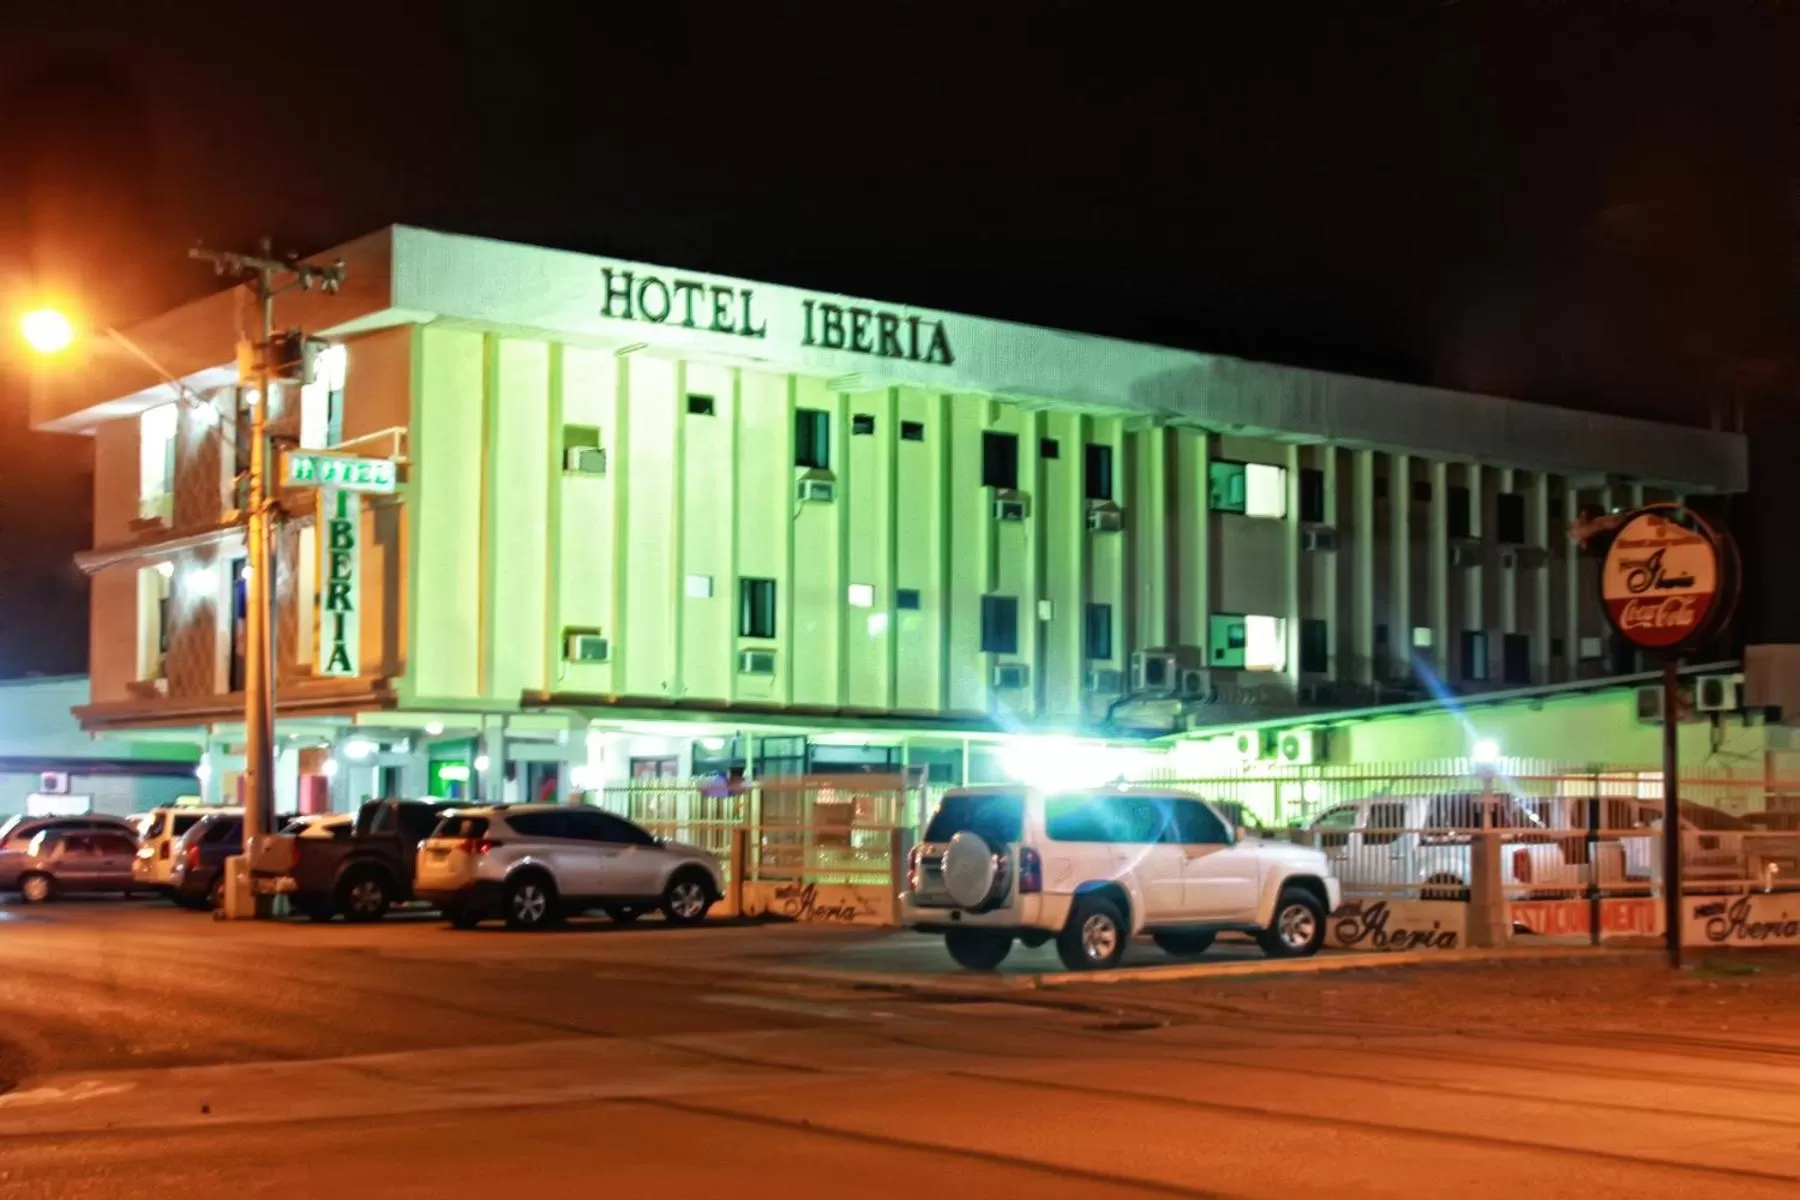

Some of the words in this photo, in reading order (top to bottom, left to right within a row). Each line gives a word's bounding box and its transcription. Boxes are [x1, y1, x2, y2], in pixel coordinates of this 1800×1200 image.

[600, 267, 767, 338] HOTEL
[801, 299, 955, 366] IBERIA
[325, 489, 355, 672] IBERIA
